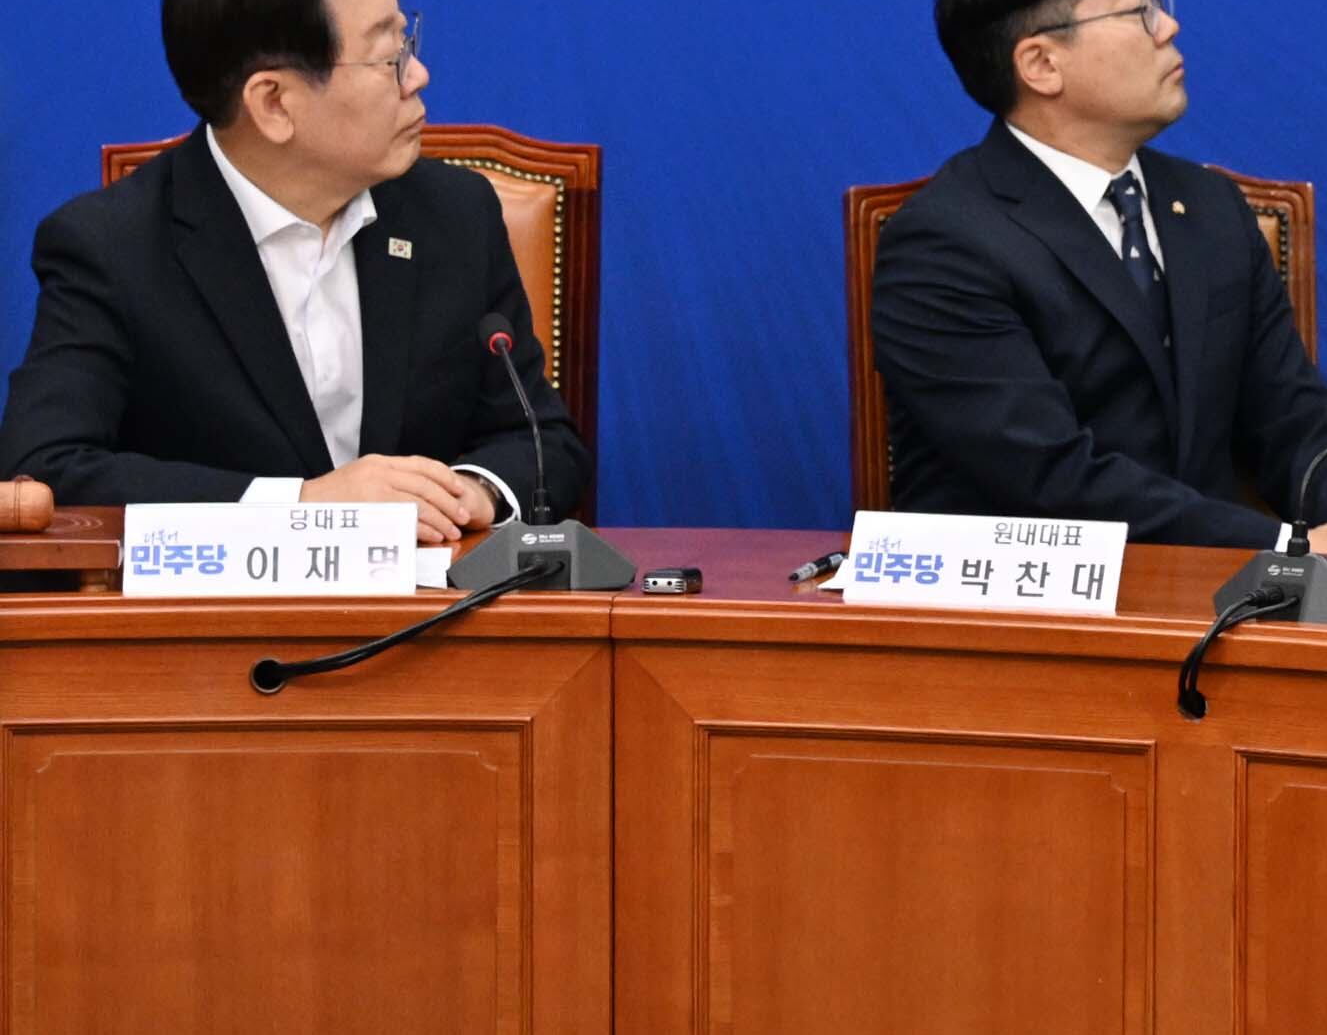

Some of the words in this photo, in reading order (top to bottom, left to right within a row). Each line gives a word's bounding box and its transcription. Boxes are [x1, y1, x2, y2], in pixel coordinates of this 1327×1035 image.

[289, 508, 360, 531] 당대표
[993, 522, 1083, 548] 원내대표
[131, 544, 228, 576] 민주당
[854, 551, 944, 585] 민주당
